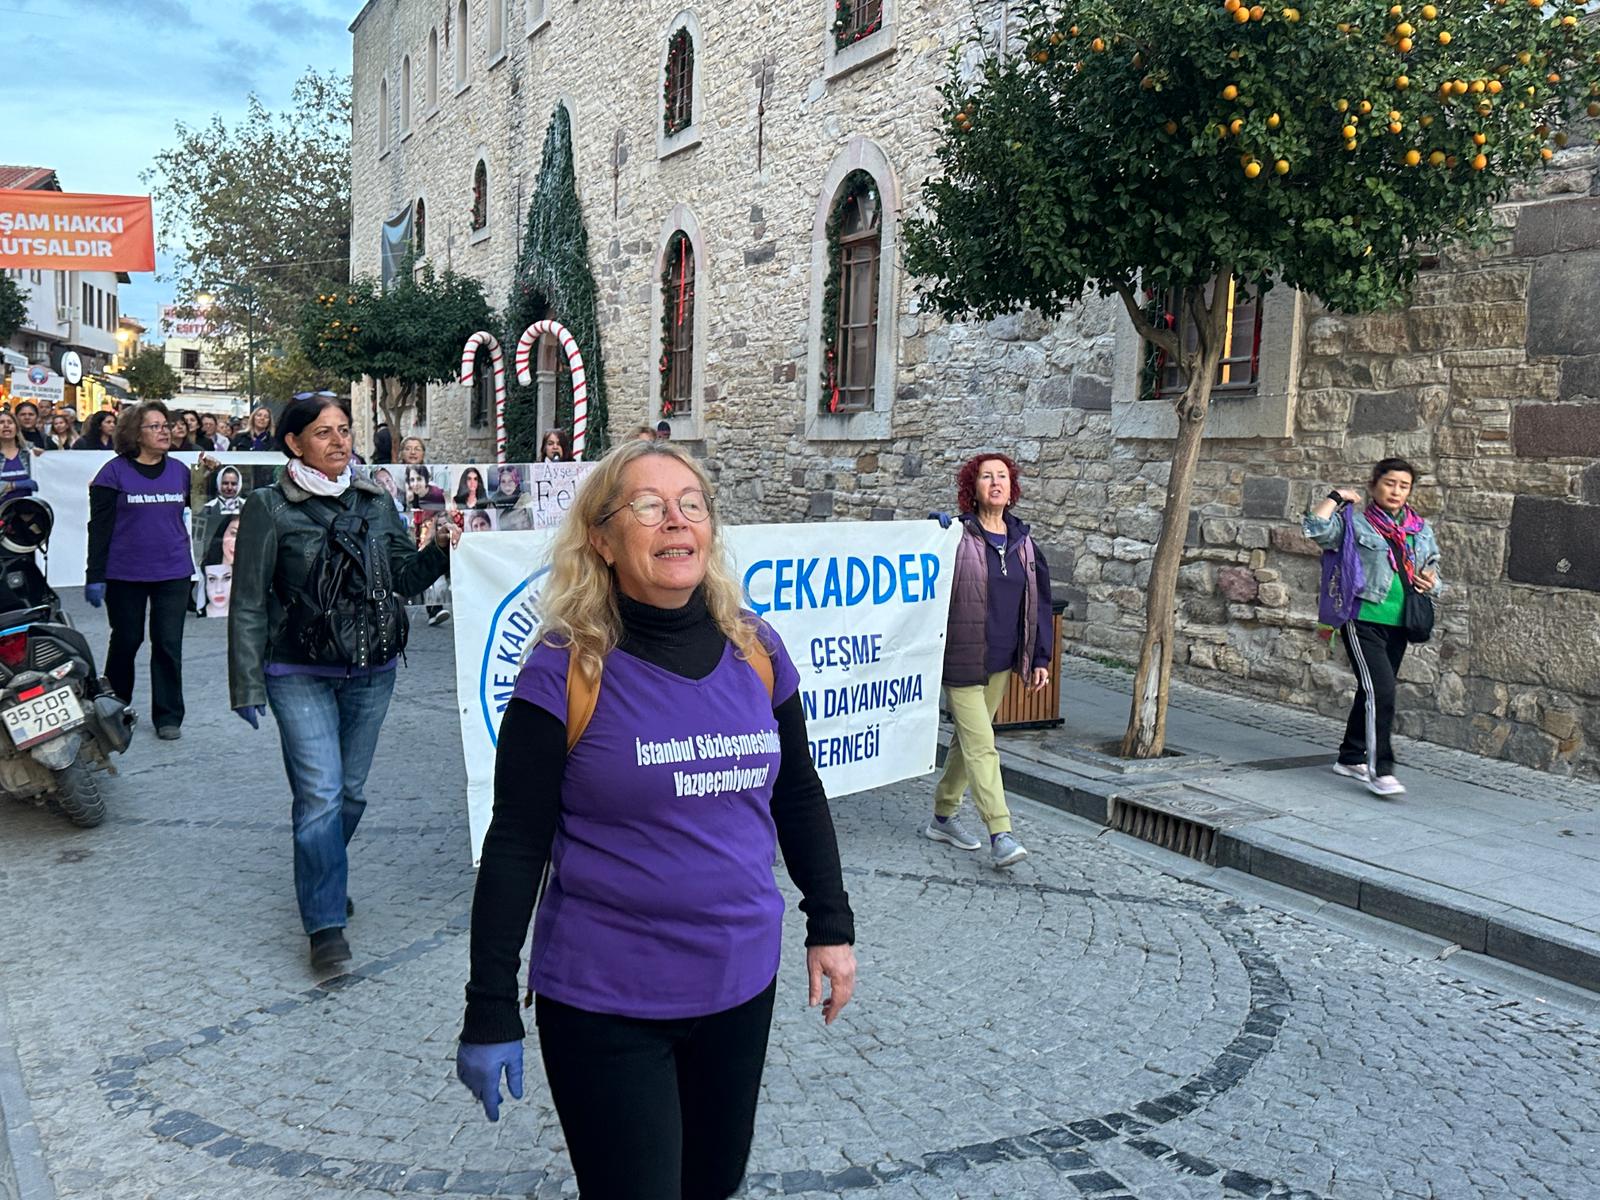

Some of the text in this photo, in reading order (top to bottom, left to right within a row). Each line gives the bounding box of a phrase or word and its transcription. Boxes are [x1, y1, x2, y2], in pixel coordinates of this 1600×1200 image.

[0, 213, 124, 235] ŞAM HAKKI
[744, 553, 940, 616] ÇEKADDER
[810, 633, 883, 674] ÇEŞME
[6, 690, 70, 726] 35 CDP
[823, 673, 923, 719] DAYANIŞMA
[33, 707, 71, 732] 703
[635, 736, 696, 767] İstanbul
